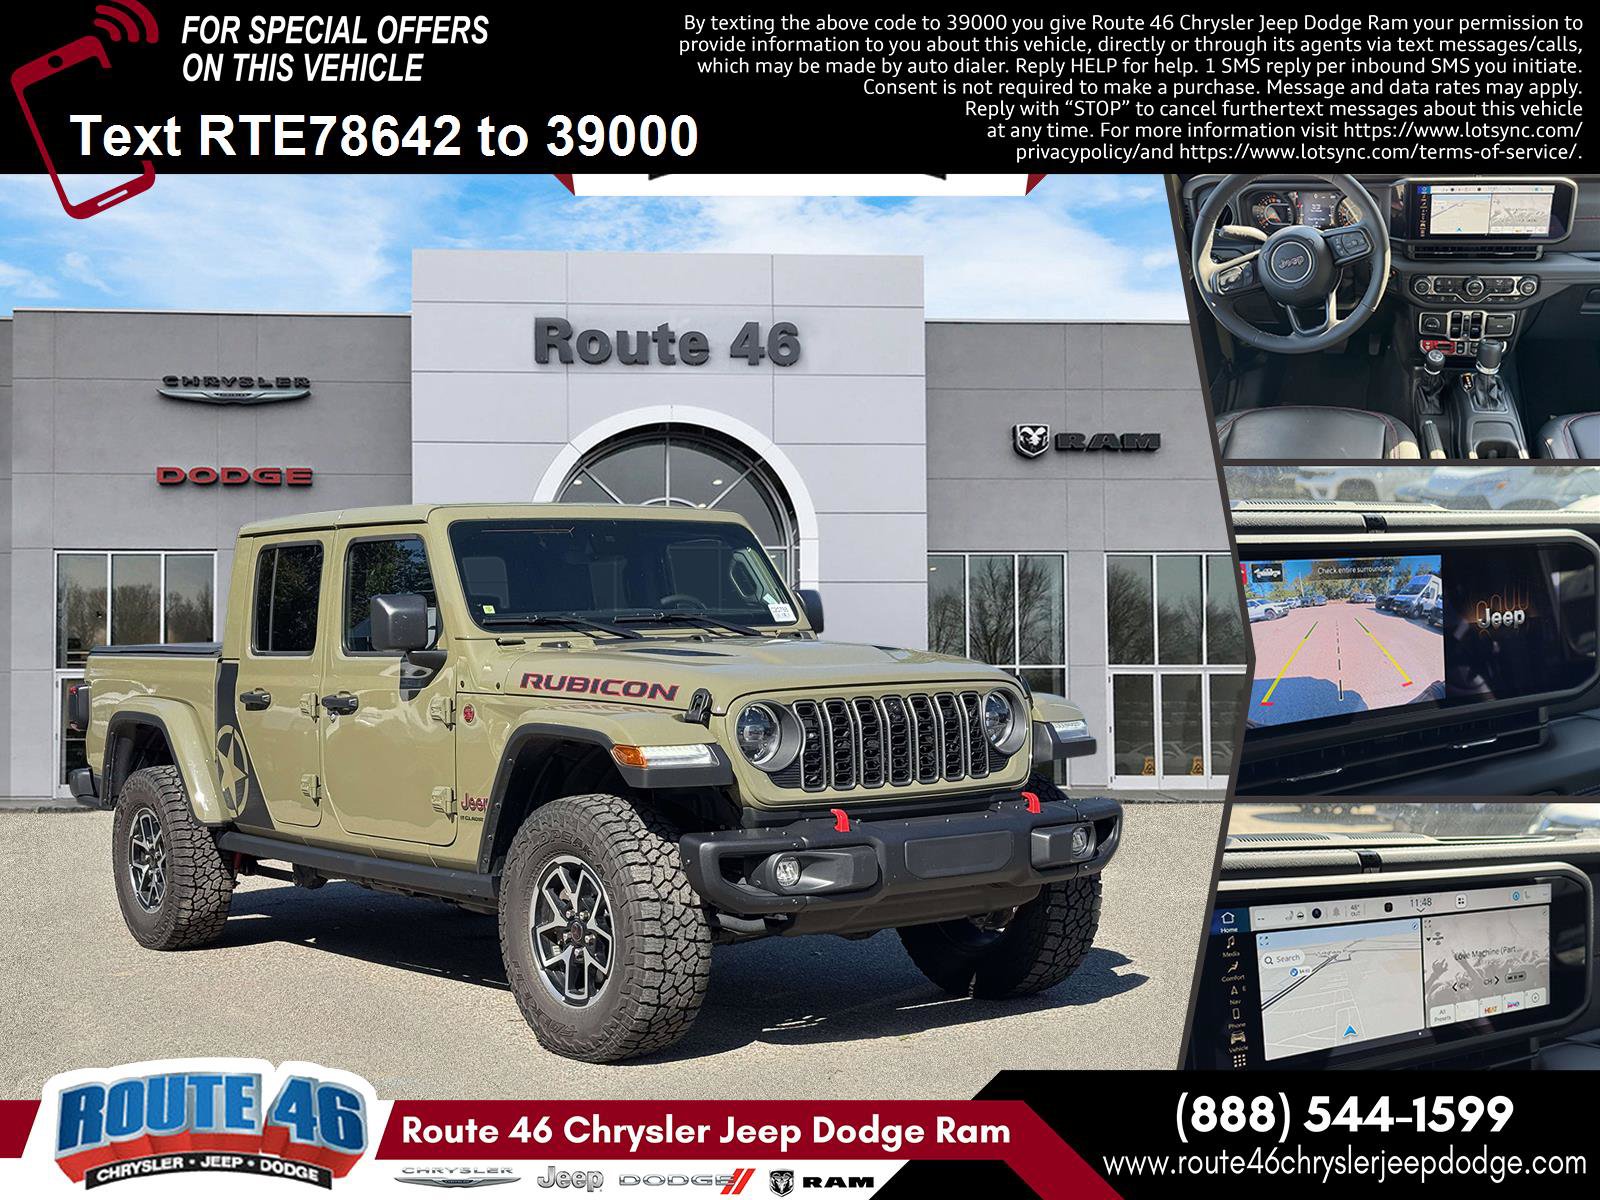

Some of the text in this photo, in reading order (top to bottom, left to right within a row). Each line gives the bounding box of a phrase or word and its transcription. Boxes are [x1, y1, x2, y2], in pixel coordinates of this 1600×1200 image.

[534, 317, 802, 367] Route 46
[162, 375, 311, 388] CHRYSLER
[1054, 432, 1162, 452] RAM
[156, 467, 313, 486] DODGE
[1478, 608, 1526, 629] Jeep
[520, 672, 680, 702] RUBICON
[1410, 897, 1433, 908] 11:48
[1222, 951, 1240, 959] Media
[1276, 955, 1301, 964] Search
[1221, 974, 1246, 983] Comfort
